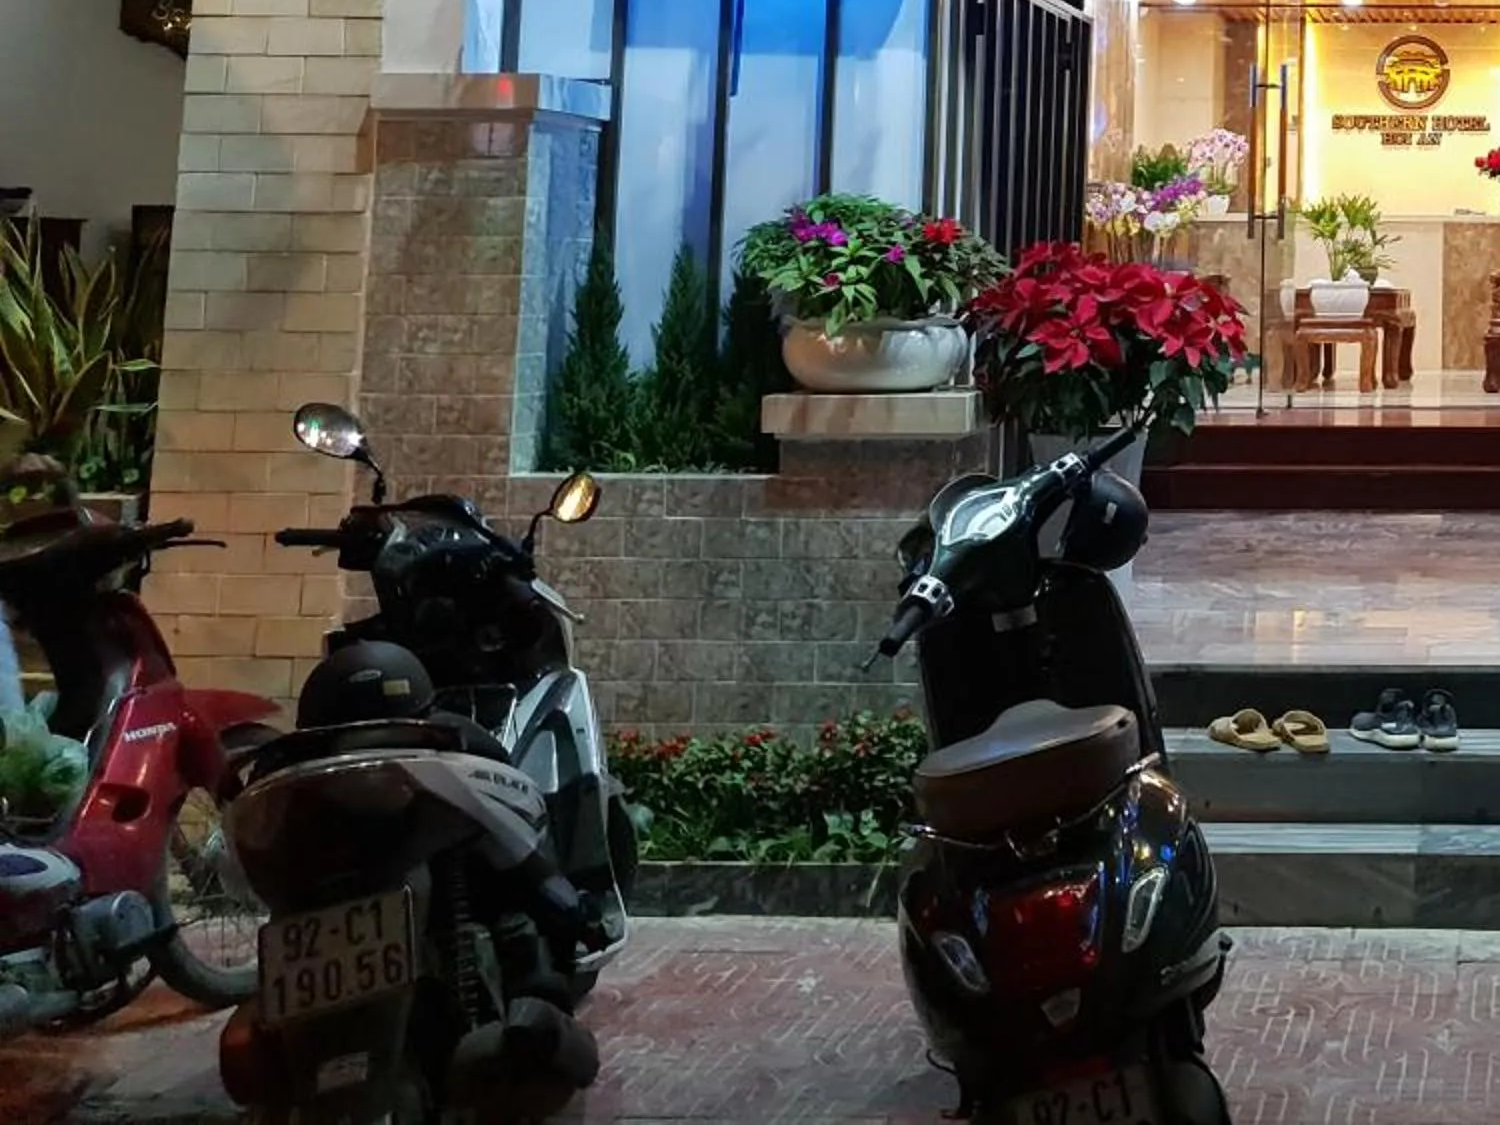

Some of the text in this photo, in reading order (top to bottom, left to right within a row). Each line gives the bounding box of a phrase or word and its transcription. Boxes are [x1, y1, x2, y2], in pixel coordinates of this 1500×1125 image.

[1331, 115, 1491, 131] SOUTHERN HOTEL
[123, 722, 177, 743] HONDA
[283, 900, 383, 962] 92-C1
[272, 942, 403, 1016] 190.56
